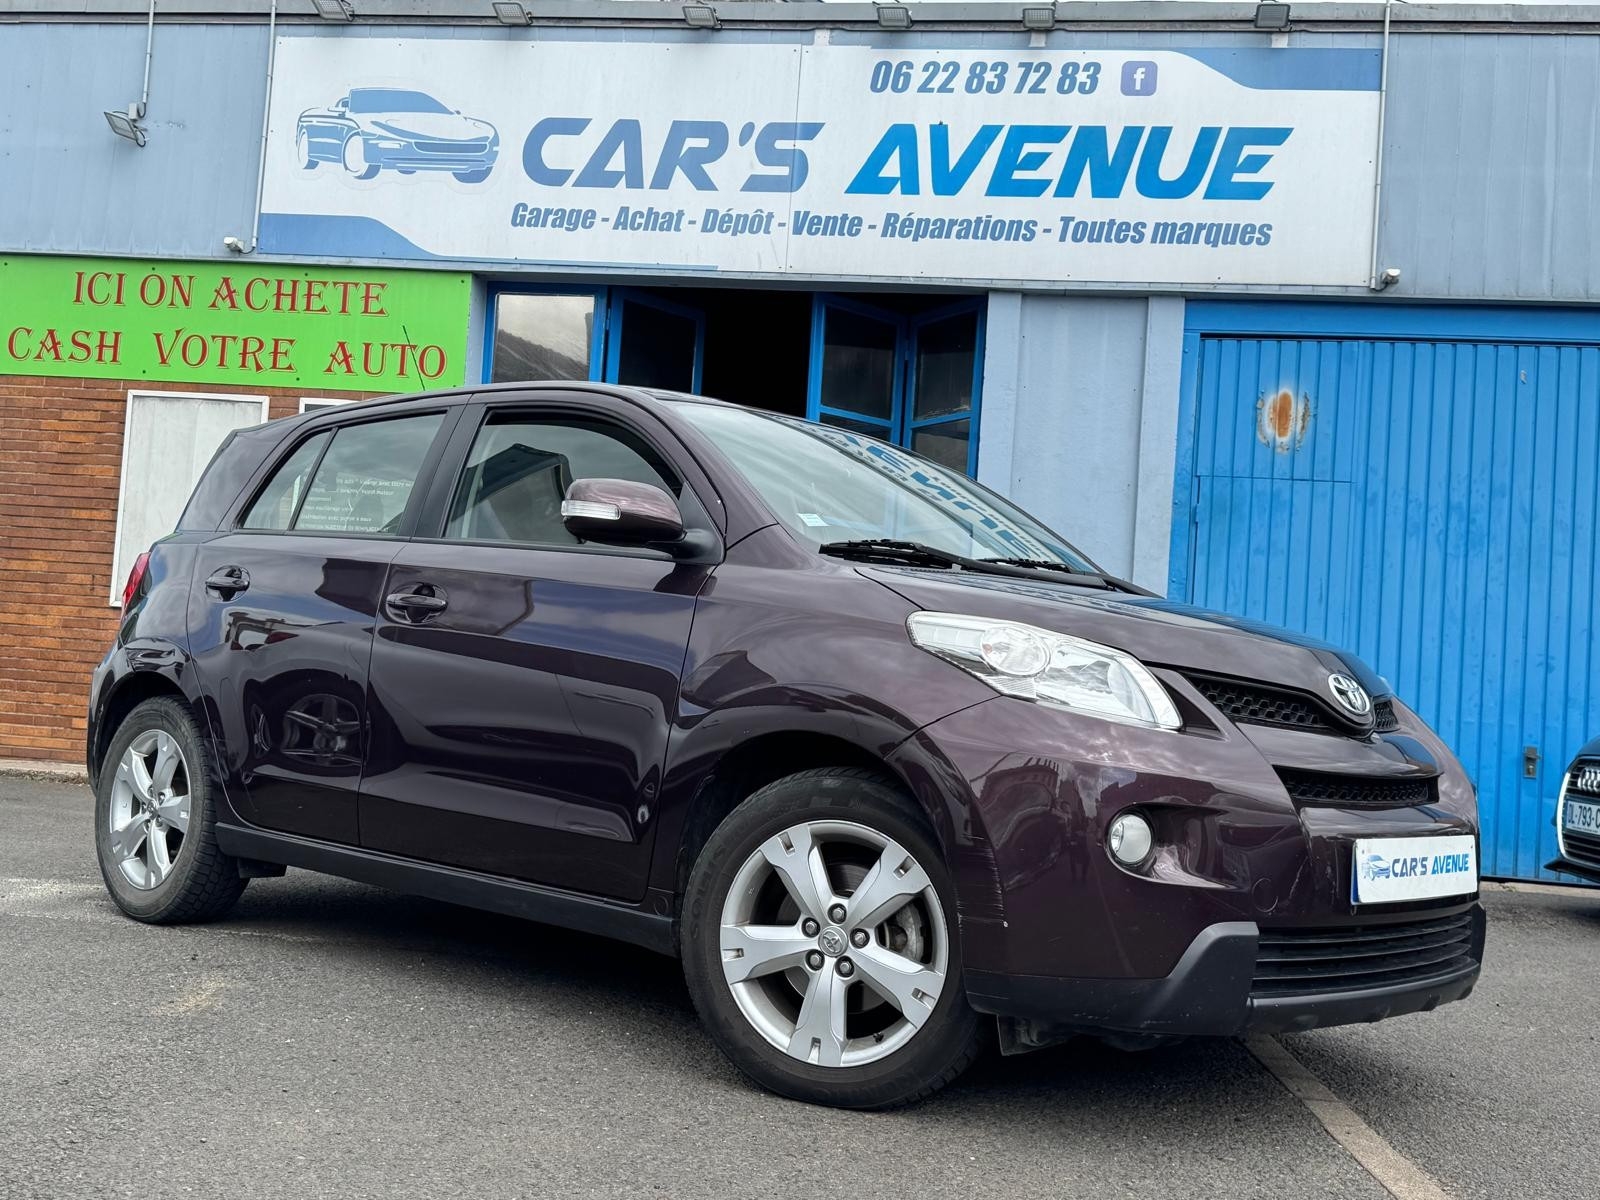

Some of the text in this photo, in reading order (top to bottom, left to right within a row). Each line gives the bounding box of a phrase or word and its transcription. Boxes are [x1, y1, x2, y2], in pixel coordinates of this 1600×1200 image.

[870, 61, 1101, 94] 06 22 83 72 83
[523, 117, 1295, 200] CAR'S AVENUE
[511, 203, 596, 231] Garage
[612, 207, 684, 232] Achat
[701, 208, 774, 236] Dépôt
[792, 211, 863, 237] Vente
[881, 212, 1038, 242] Réparations
[1059, 216, 1147, 244] Toutes
[1150, 221, 1272, 248] marques
[74, 272, 387, 316] ICI ON ACHETE
[8, 327, 447, 378] CASH VOTRE AUTO
[1391, 853, 1469, 878] CAR'S AVENUE
